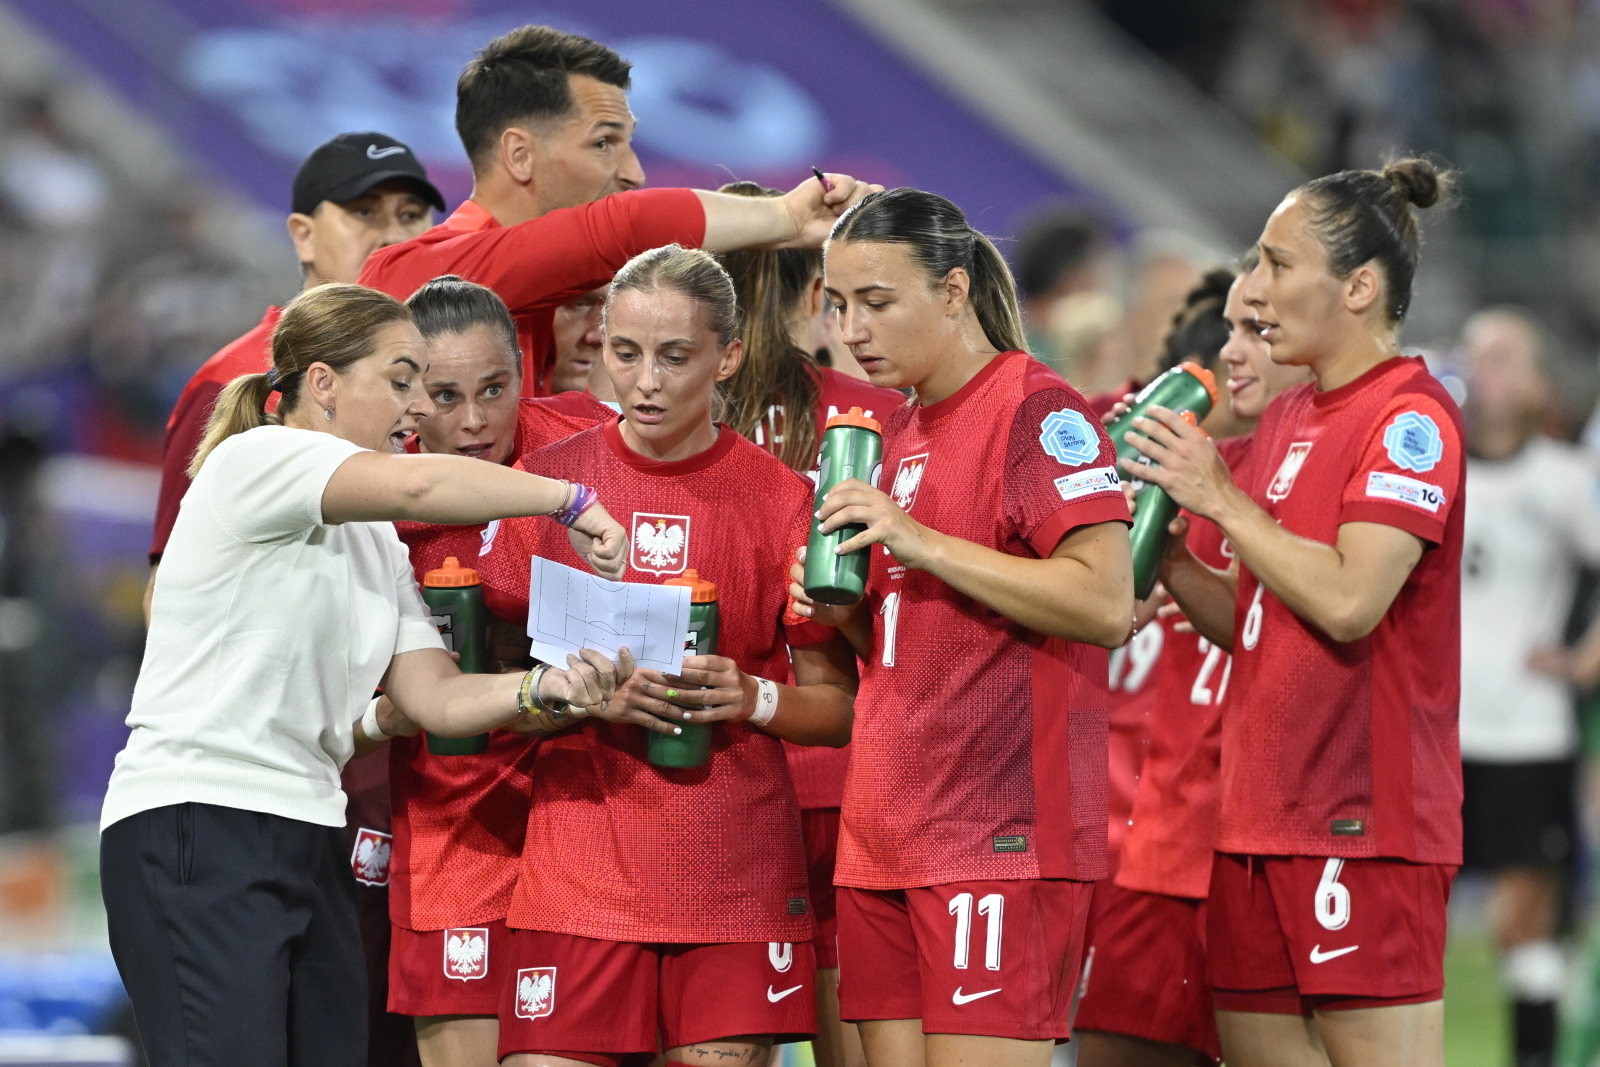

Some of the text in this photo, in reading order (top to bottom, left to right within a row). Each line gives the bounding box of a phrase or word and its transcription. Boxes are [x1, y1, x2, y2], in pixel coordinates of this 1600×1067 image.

[1059, 476, 1107, 492] FOUNDATION
[1314, 857, 1351, 931] 6
[948, 892, 1005, 971] 11
